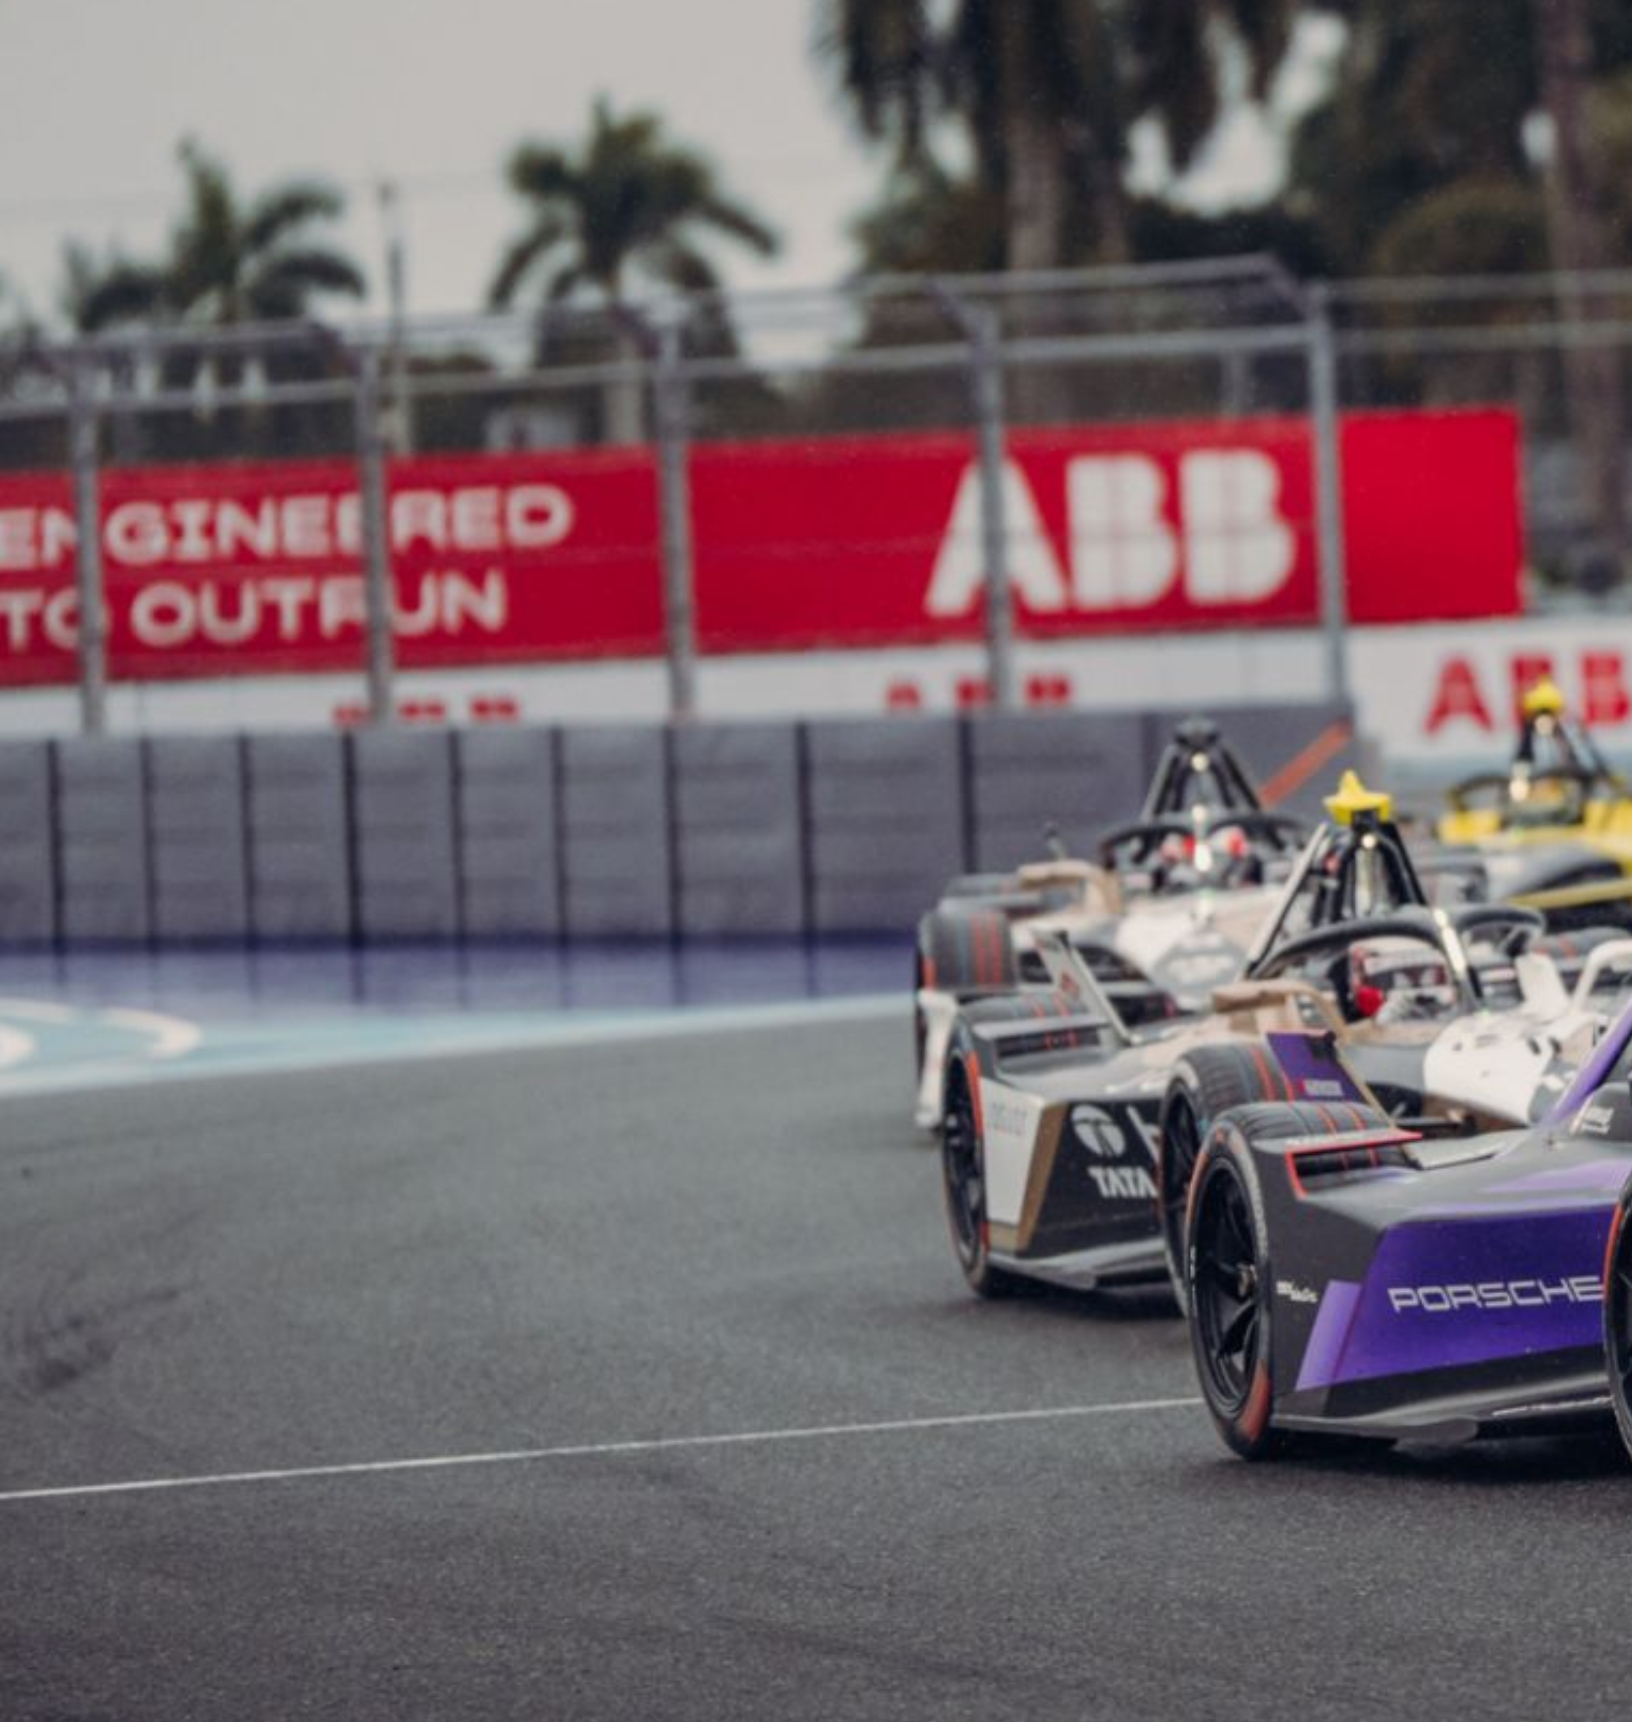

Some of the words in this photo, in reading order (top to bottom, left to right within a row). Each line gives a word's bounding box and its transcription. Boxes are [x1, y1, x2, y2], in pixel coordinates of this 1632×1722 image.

[924, 448, 1296, 616] ABB
[0, 582, 112, 652] TO
[131, 568, 507, 646] OUTRUN
[1087, 1166, 1160, 1199] TATA
[1387, 1273, 1606, 1314] PORSCHE
